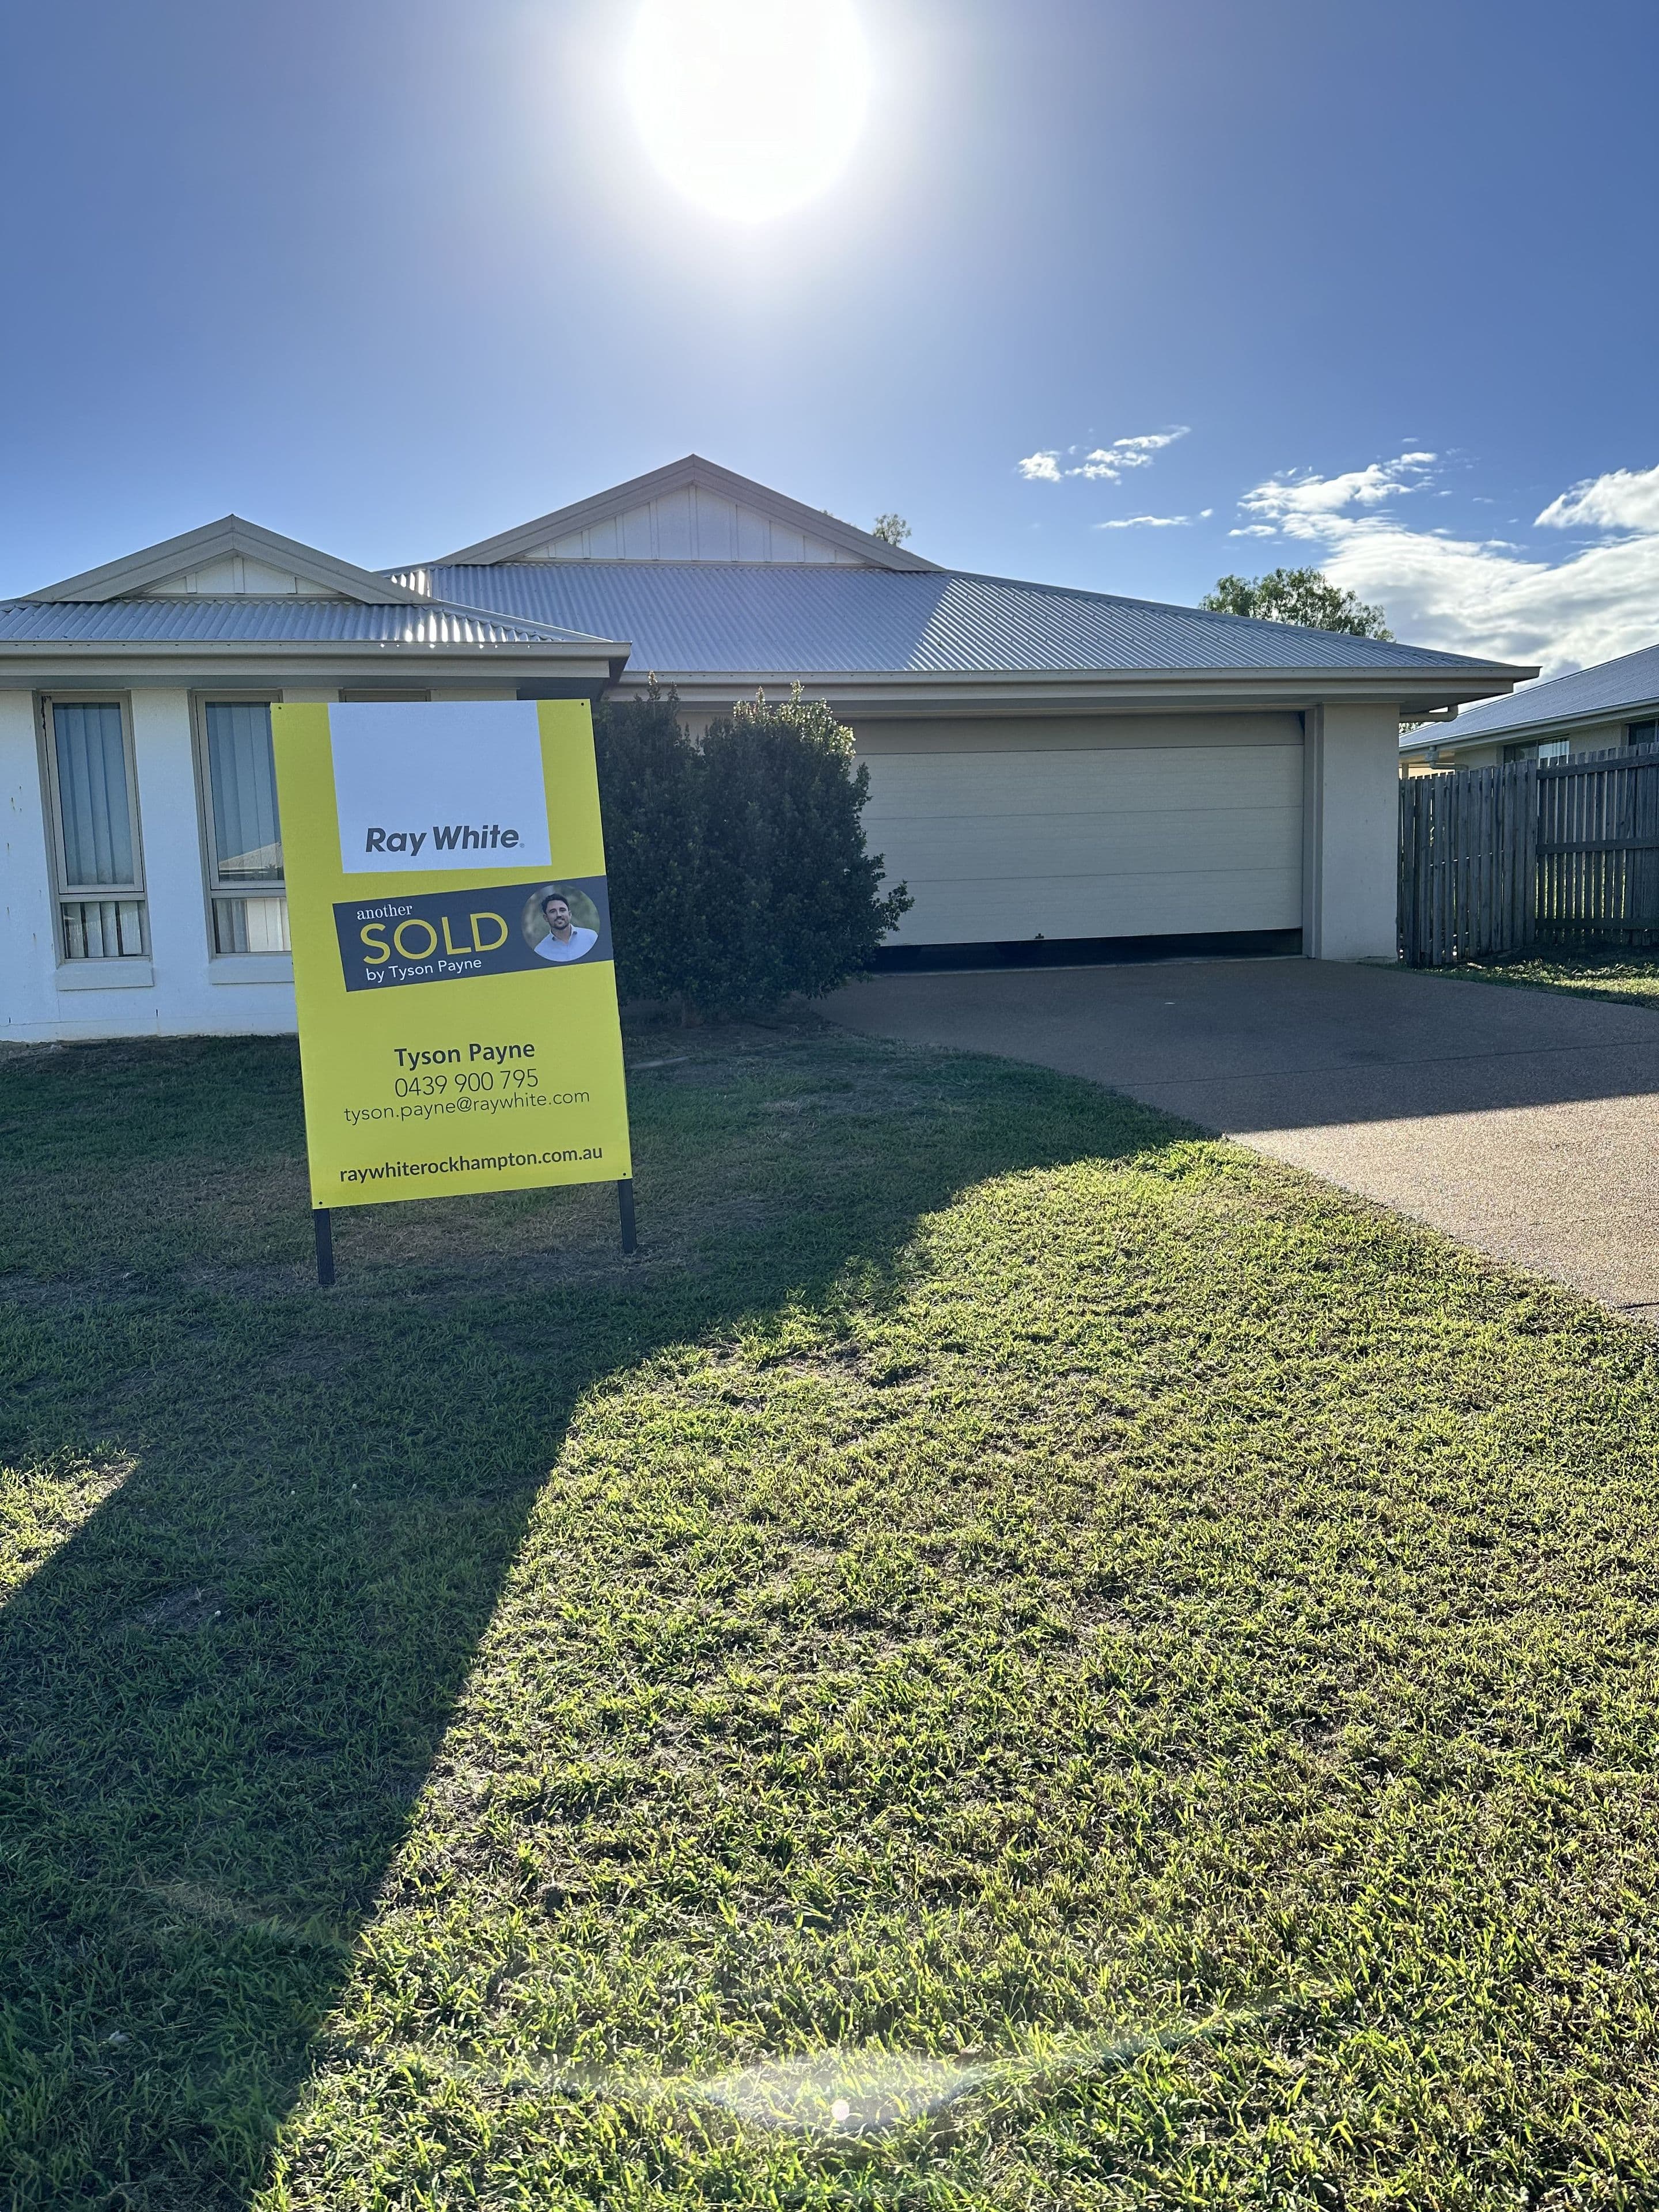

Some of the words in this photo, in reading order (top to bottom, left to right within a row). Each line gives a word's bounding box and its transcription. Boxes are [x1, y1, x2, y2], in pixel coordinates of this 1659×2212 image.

[365, 827, 427, 856] Ray
[433, 824, 519, 850] White
[357, 904, 412, 920] another
[360, 912, 509, 964] SOLD
[366, 968, 384, 983] by
[388, 963, 433, 980] Tyson
[438, 959, 482, 974] Payne
[395, 1048, 460, 1071] Tyson
[469, 1043, 536, 1065] Payne
[395, 1075, 448, 1097] 0439
[455, 1071, 494, 1093] 900
[501, 1069, 538, 1089] 795
[344, 1092, 590, 1125] tyson.payne@raywhite.com
[340, 1146, 603, 1183] raywhiterockhampton.com.au
